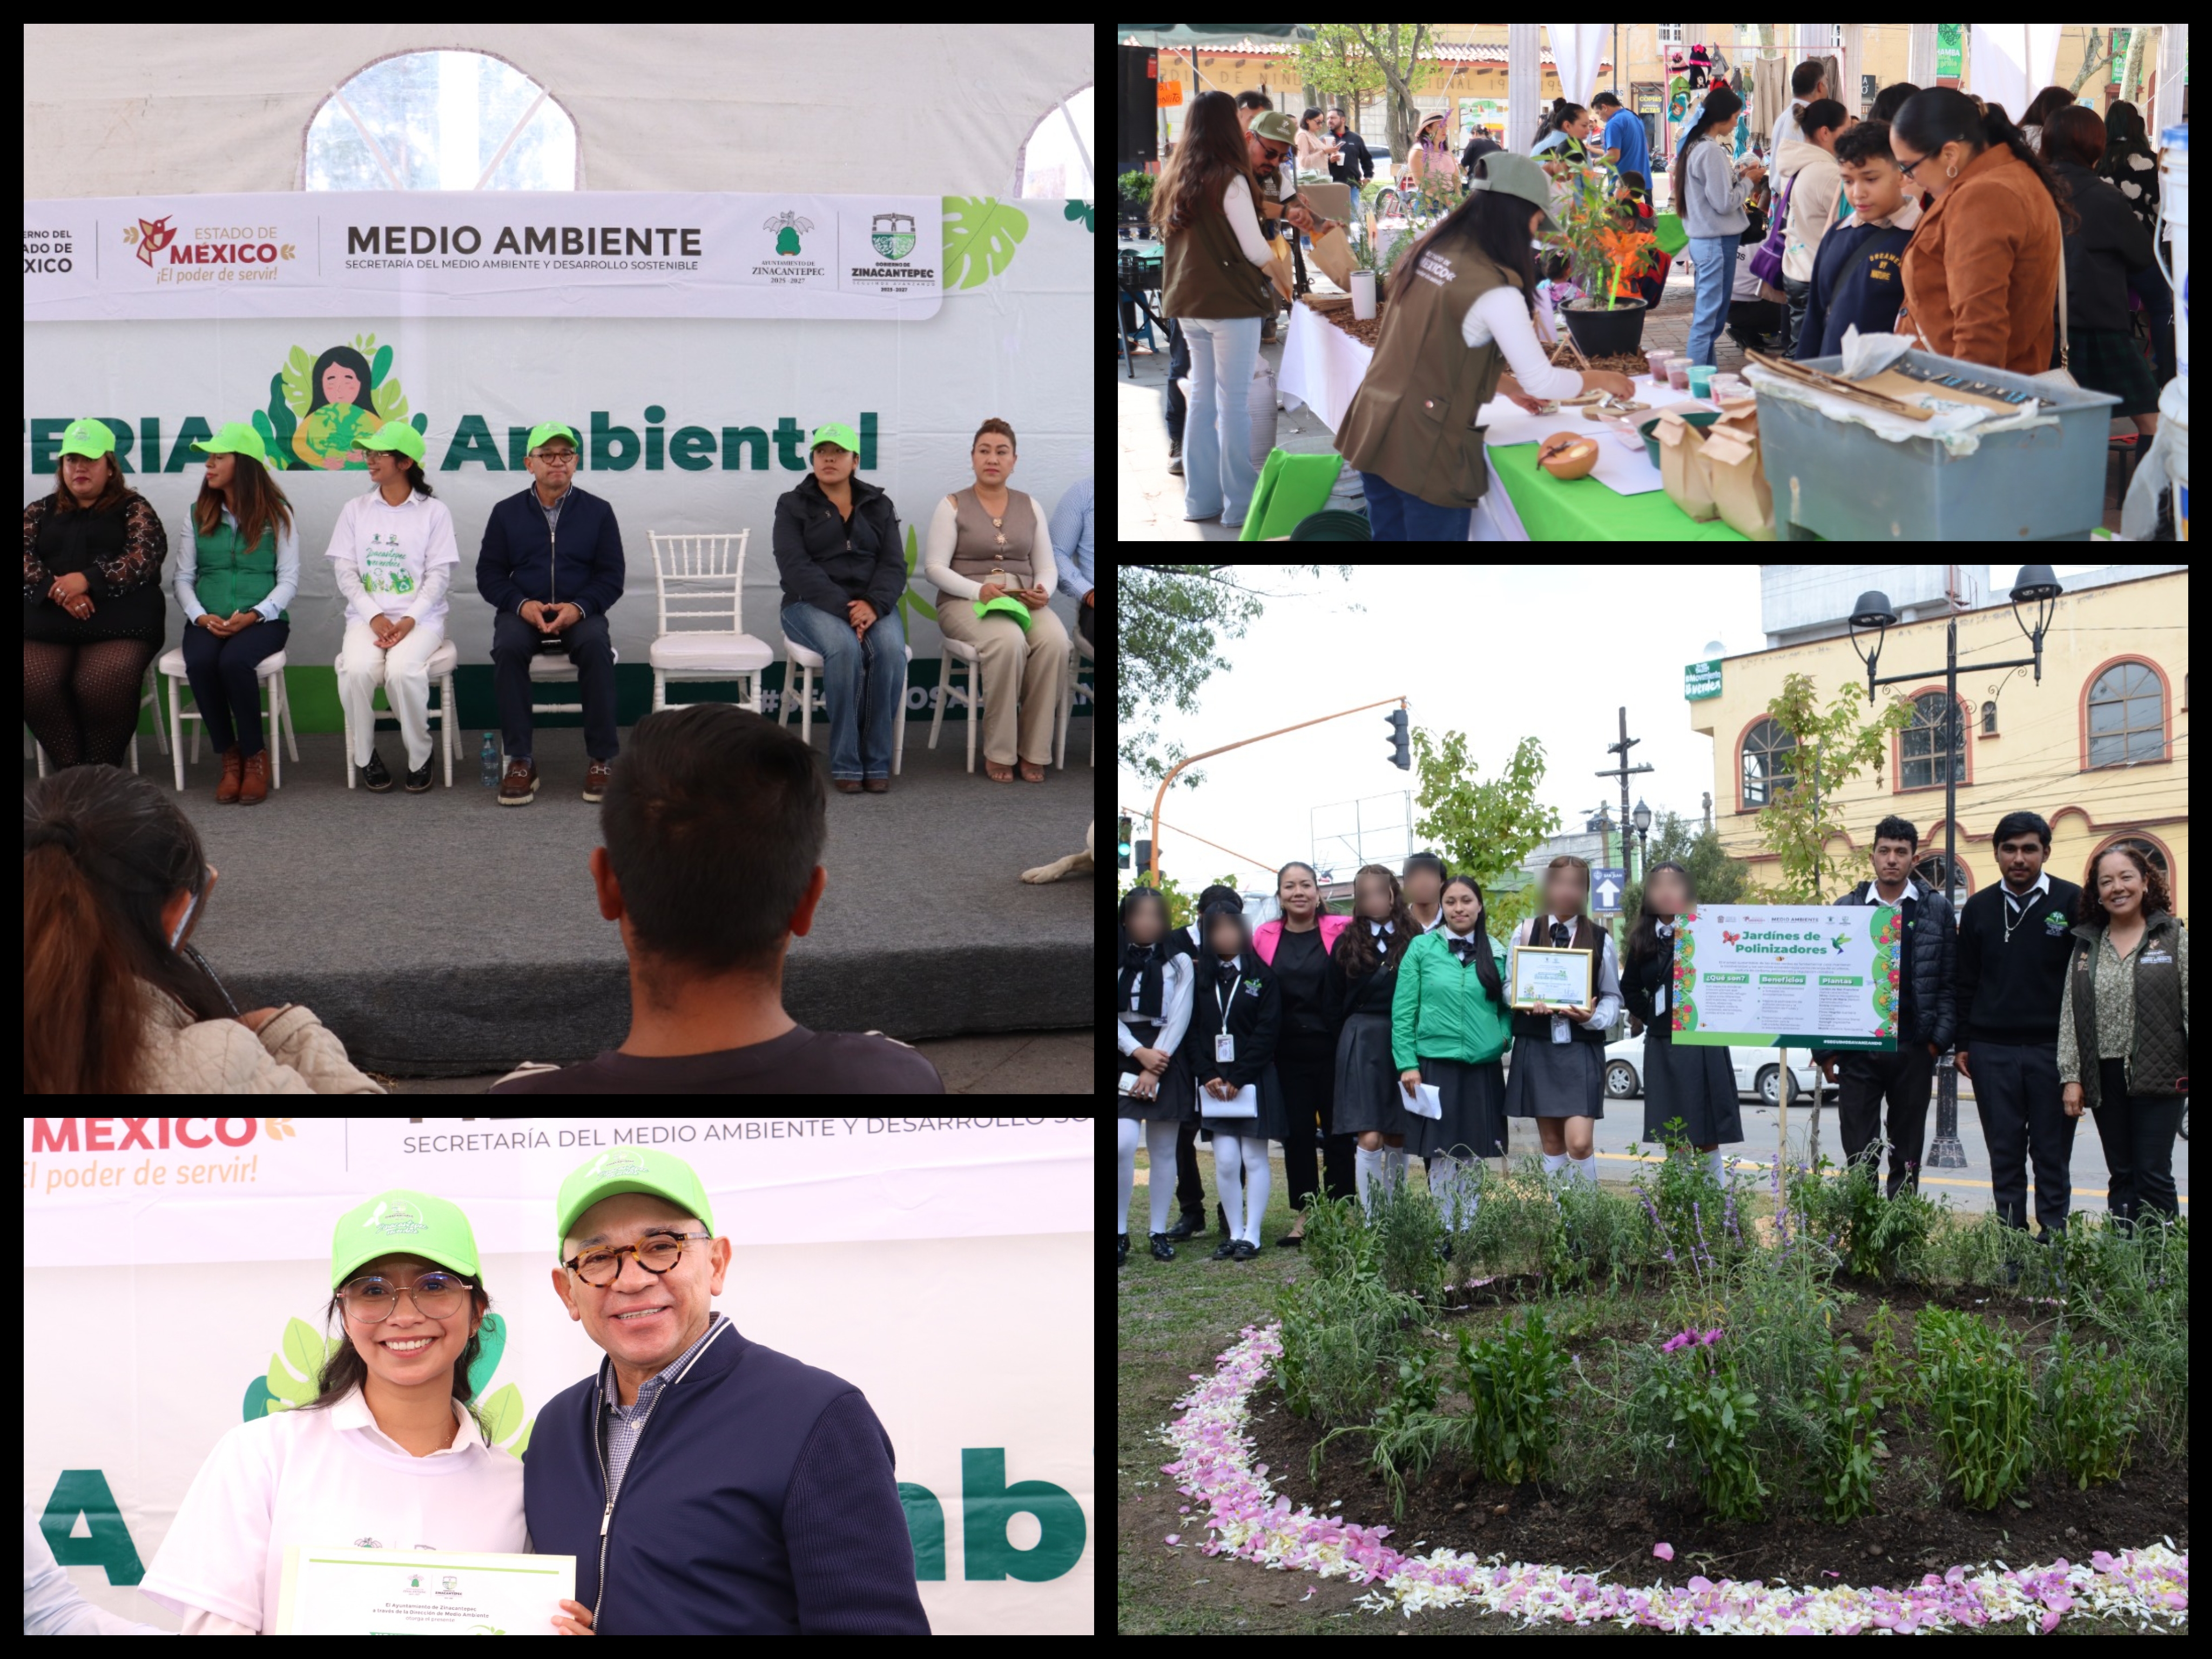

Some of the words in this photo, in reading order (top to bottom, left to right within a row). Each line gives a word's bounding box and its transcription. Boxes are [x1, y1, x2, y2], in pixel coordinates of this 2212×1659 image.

[1937, 49, 1960, 57] HAMBA
[195, 227, 254, 240] ESTADO
[258, 227, 278, 239] DE
[348, 226, 482, 254] MEDIO
[493, 226, 702, 256] AMBIENTE
[55, 244, 72, 253] DE
[170, 242, 278, 264] MÉXICO
[346, 258, 413, 269] SECRETARÍA
[417, 259, 439, 268] DEL
[442, 259, 480, 269] MEDIO
[483, 260, 540, 269] AMBIENTE
[543, 261, 551, 269] Y
[554, 260, 628, 269] DESARROLLO
[631, 261, 698, 270] SOSTENIBLE
[1879, 260, 1889, 269] BY
[157, 268, 172, 285] ¡El
[177, 267, 214, 285] poder
[218, 267, 234, 281] de
[239, 266, 278, 281] servir!
[752, 266, 825, 276] ZINACANTEPEC
[852, 268, 934, 278] ZINACANTEPEC
[1870, 269, 1891, 280] NATURE
[440, 405, 878, 471] Abientl
[1742, 930, 1799, 941] Jardínes
[1804, 931, 1820, 941] de
[1735, 943, 1827, 954] Polinizadores
[1706, 974, 1726, 982] ¿Qué
[403, 1128, 551, 1154] SECRETARÍA
[558, 1129, 606, 1148] DEL
[614, 1125, 697, 1145] MEDIO
[704, 1119, 835, 1142] AMBIENTE
[842, 1118, 859, 1135] Y
[46, 1159, 125, 1195] poder
[133, 1158, 167, 1186] de
[177, 1155, 258, 1185] servir!
